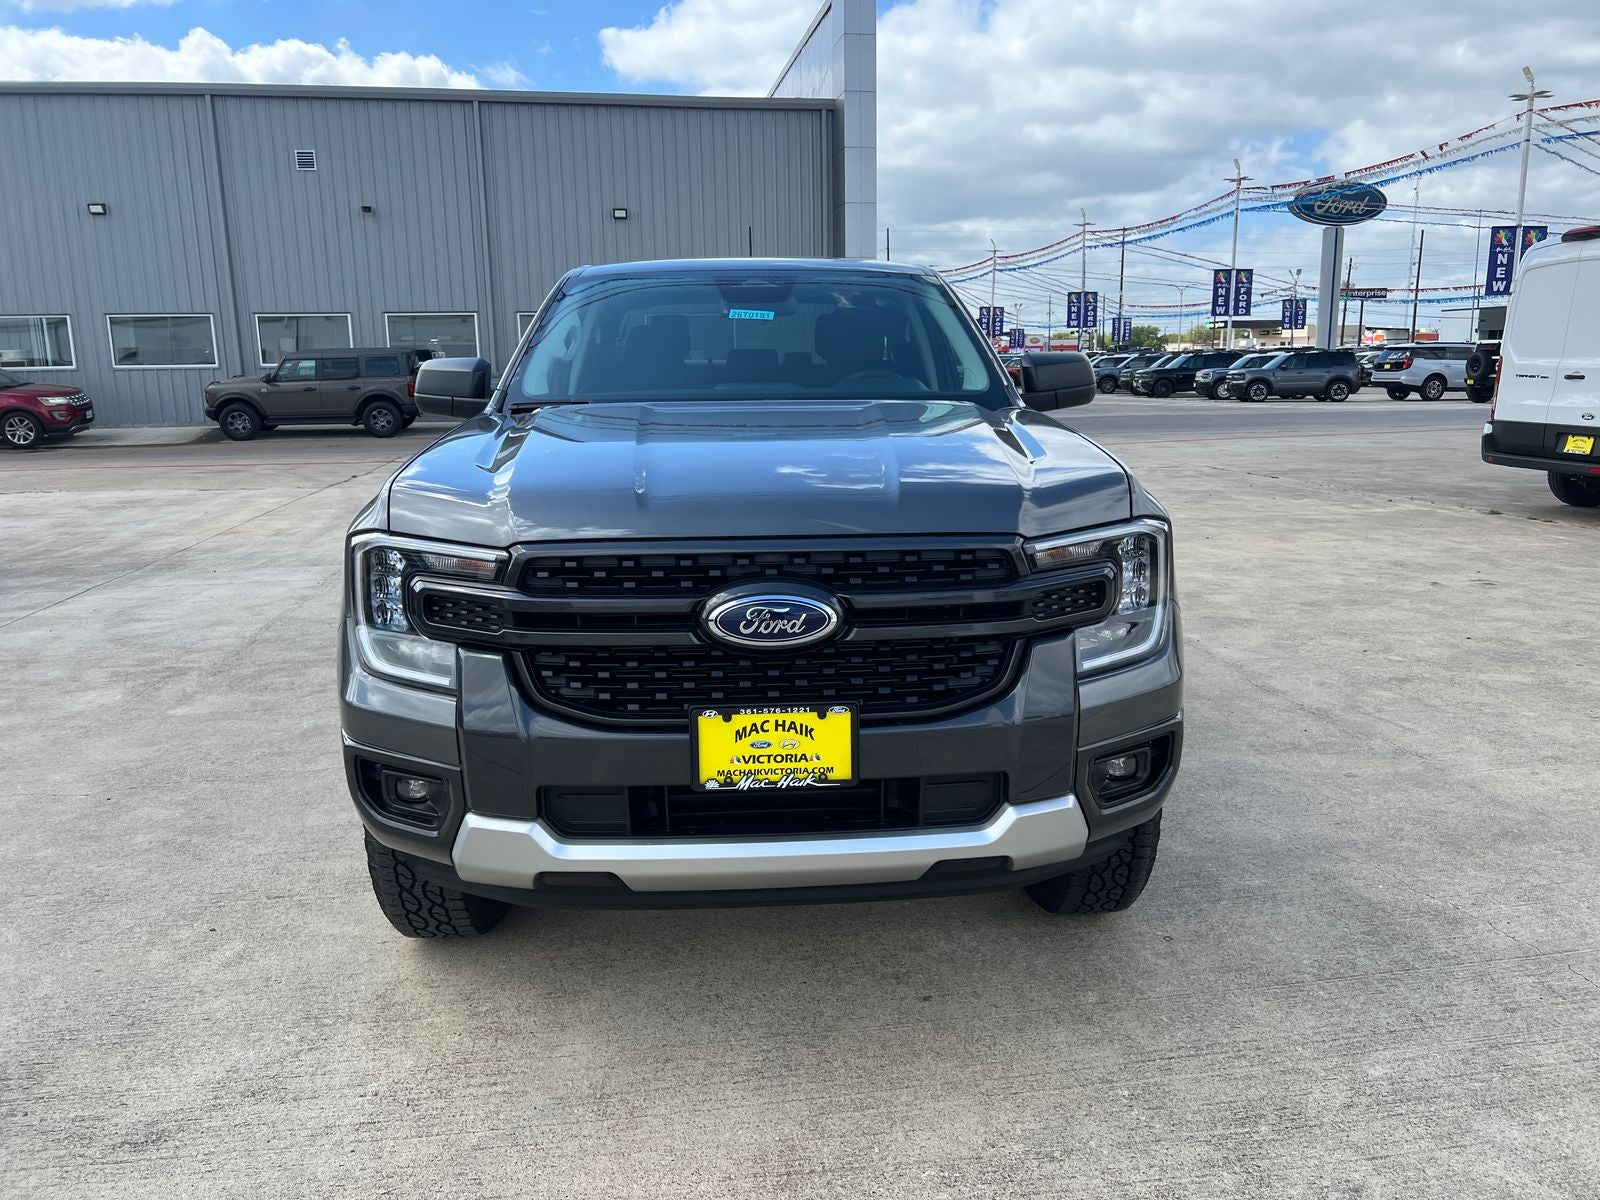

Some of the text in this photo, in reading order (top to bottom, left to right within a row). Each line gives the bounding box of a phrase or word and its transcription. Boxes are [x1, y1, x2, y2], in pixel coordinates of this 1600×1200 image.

[1314, 188, 1370, 214] Ford
[1492, 253, 1508, 292] NEW
[1215, 287, 1226, 314] NEW
[1238, 287, 1247, 315] FORD
[1070, 305, 1078, 327] NEW
[1283, 311, 1291, 329] NEW
[739, 606, 807, 634] Ford
[739, 706, 811, 715] 361-576-1221
[734, 719, 815, 743] MAC HAIK
[741, 753, 809, 765] VICTORIA
[716, 766, 834, 777] MACHAIKVICTORIA.COM
[735, 772, 817, 790] Mac Haik
